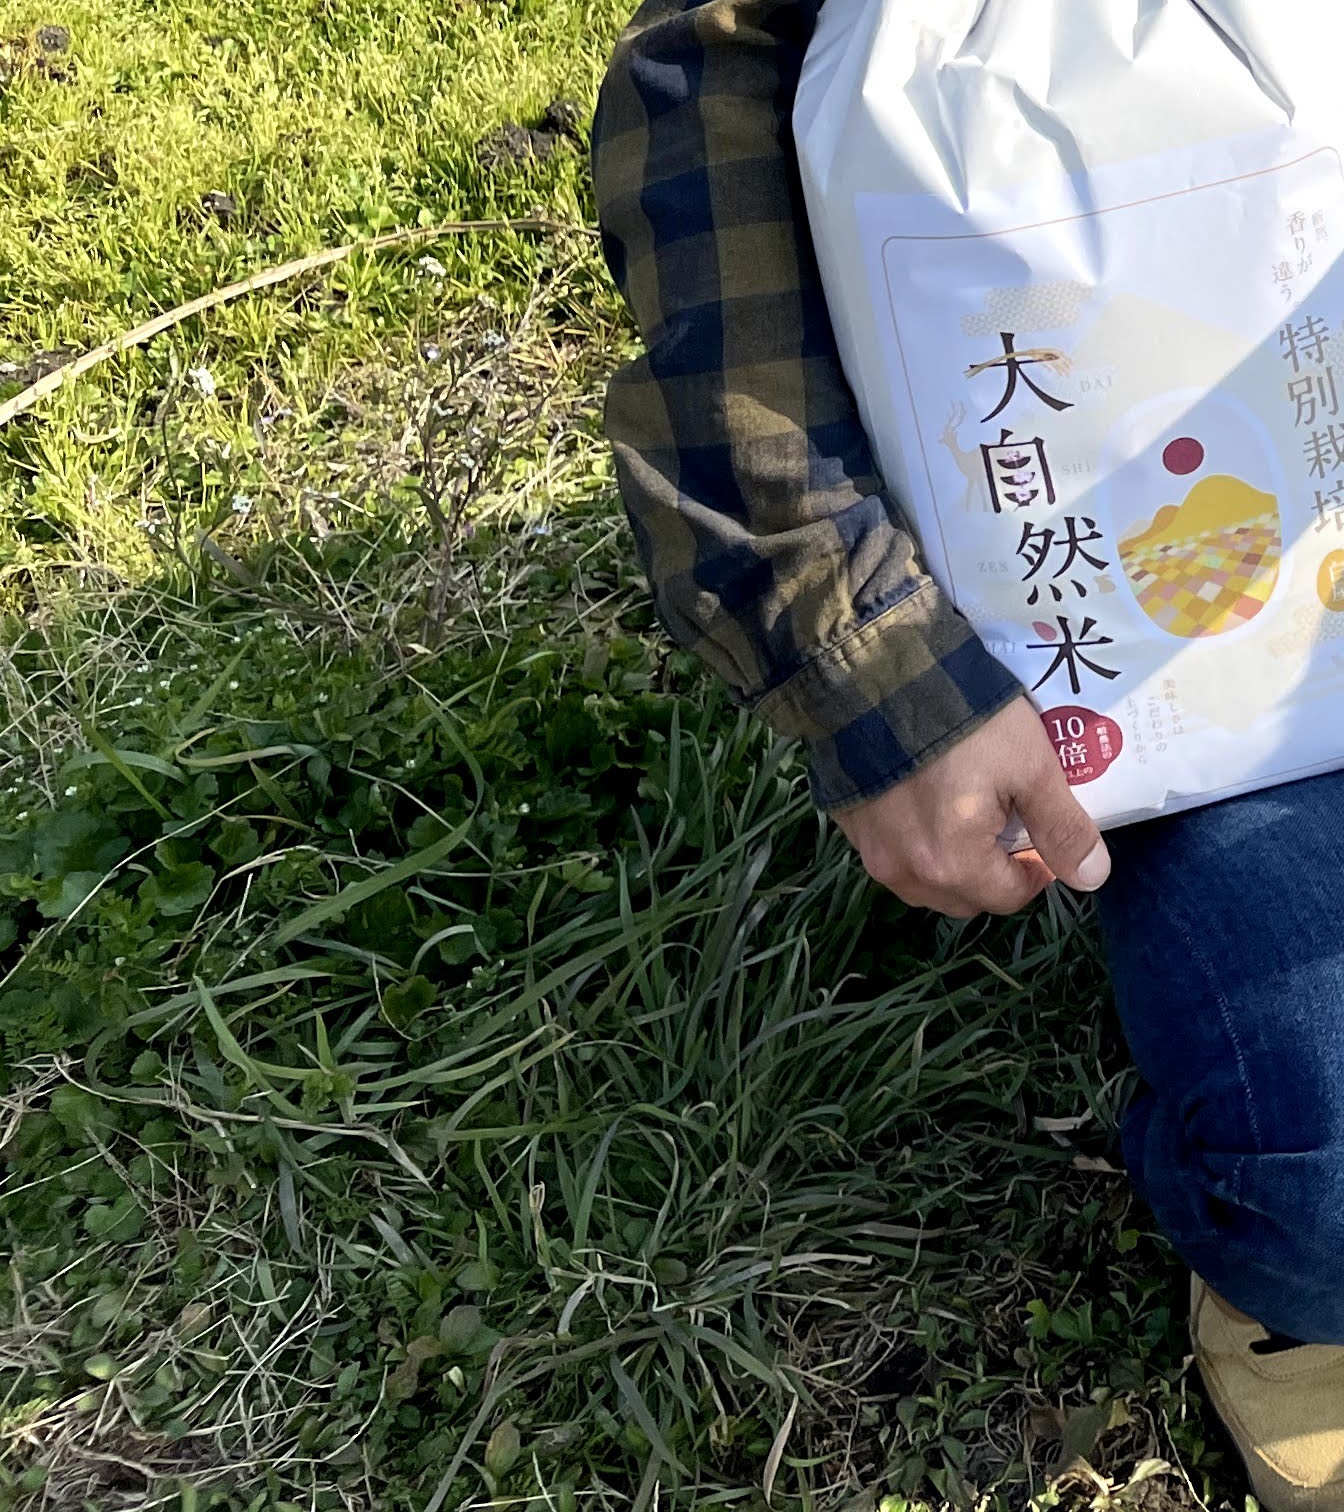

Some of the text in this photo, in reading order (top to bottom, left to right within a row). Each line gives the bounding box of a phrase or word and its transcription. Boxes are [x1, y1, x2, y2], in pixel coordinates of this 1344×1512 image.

[1080, 375, 1113, 393] DAI
[966, 331, 1122, 695] 大自然米
[1051, 716, 1085, 743] 10
